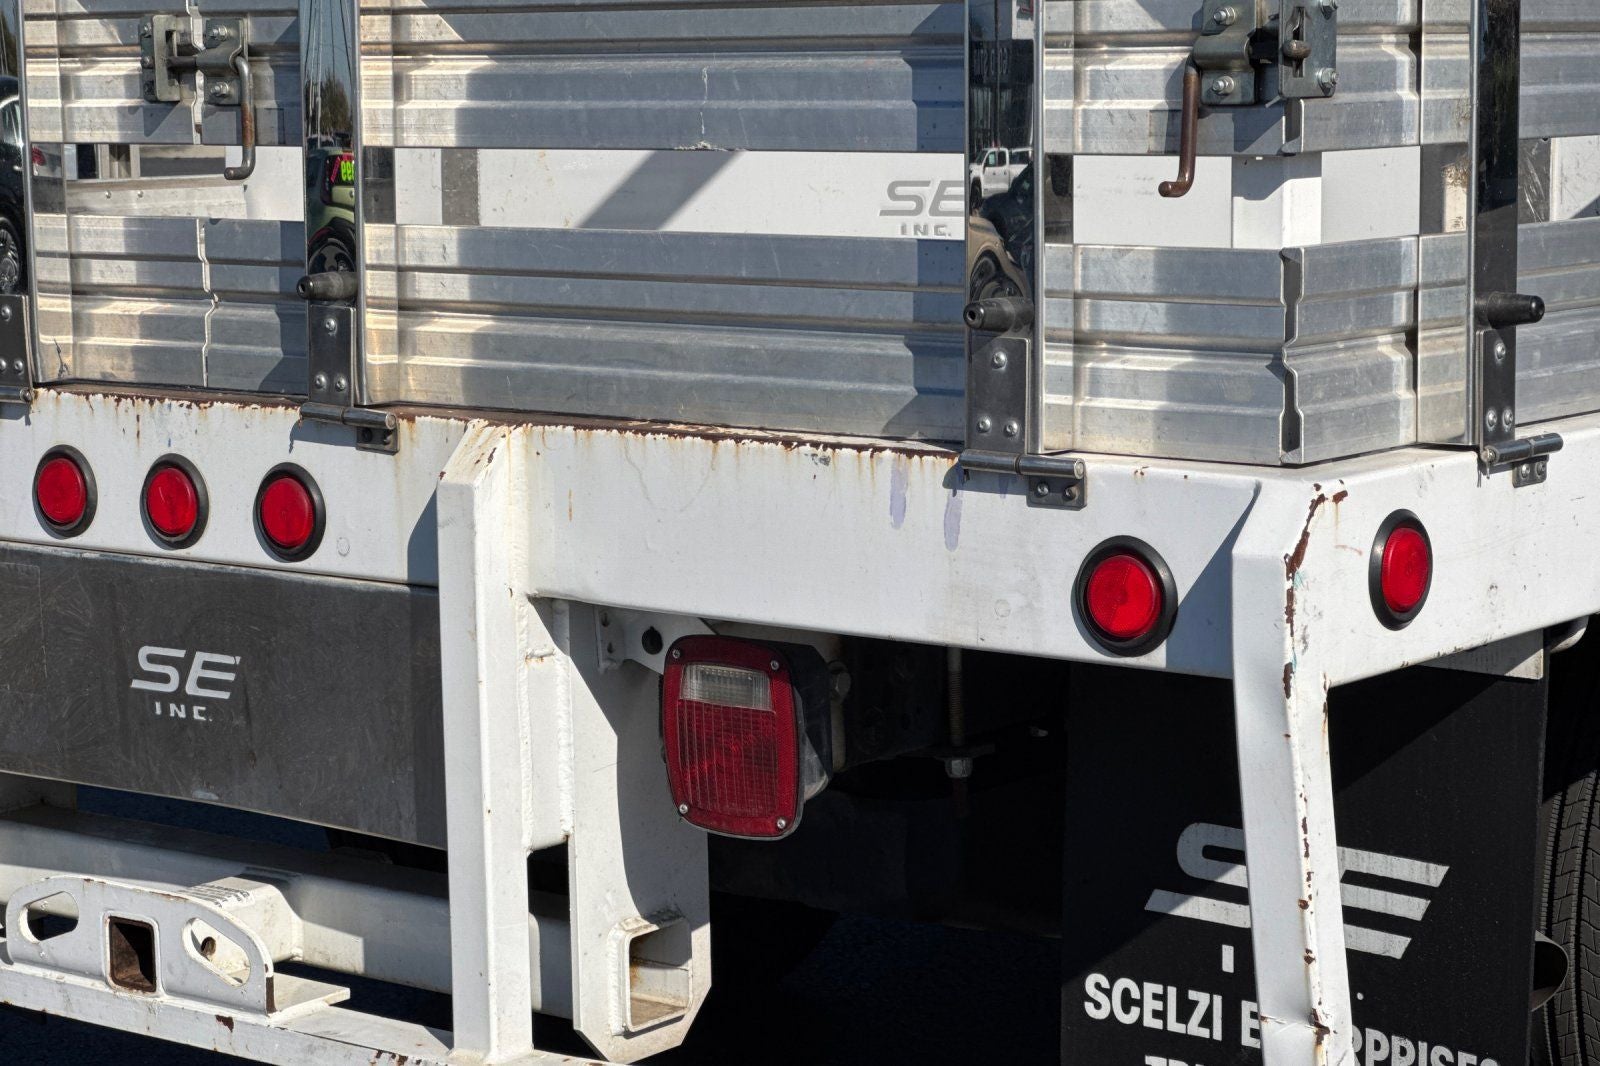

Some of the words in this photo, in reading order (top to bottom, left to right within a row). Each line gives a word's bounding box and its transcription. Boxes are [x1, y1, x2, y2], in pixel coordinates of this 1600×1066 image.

[879, 180, 965, 216] SE
[900, 223, 952, 237] INC.
[131, 646, 241, 699] SE
[154, 701, 213, 721] INC.
[1084, 973, 1223, 1041] SCELZI
